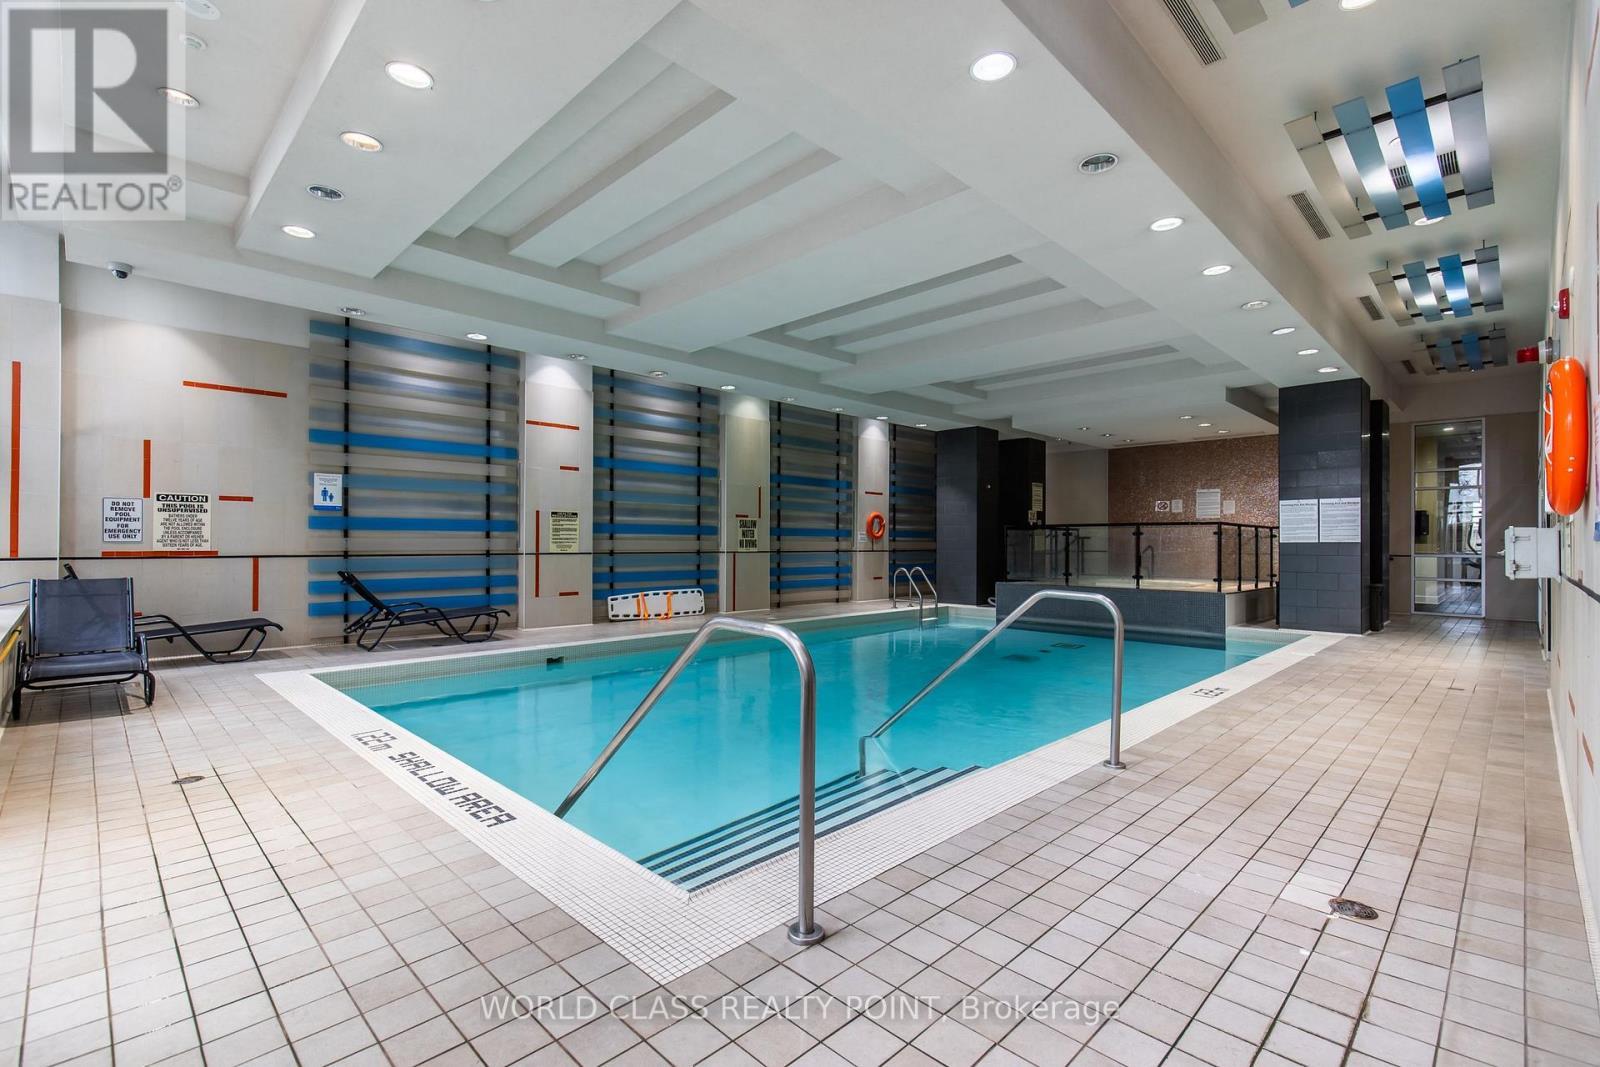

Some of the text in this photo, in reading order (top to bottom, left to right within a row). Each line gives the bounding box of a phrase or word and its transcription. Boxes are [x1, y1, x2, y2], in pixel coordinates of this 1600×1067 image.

[740, 520, 757, 529] SHALLOW
[745, 539, 758, 548] DIVING
[388, 751, 470, 796] SHALLOW
[449, 792, 518, 828] AREA
